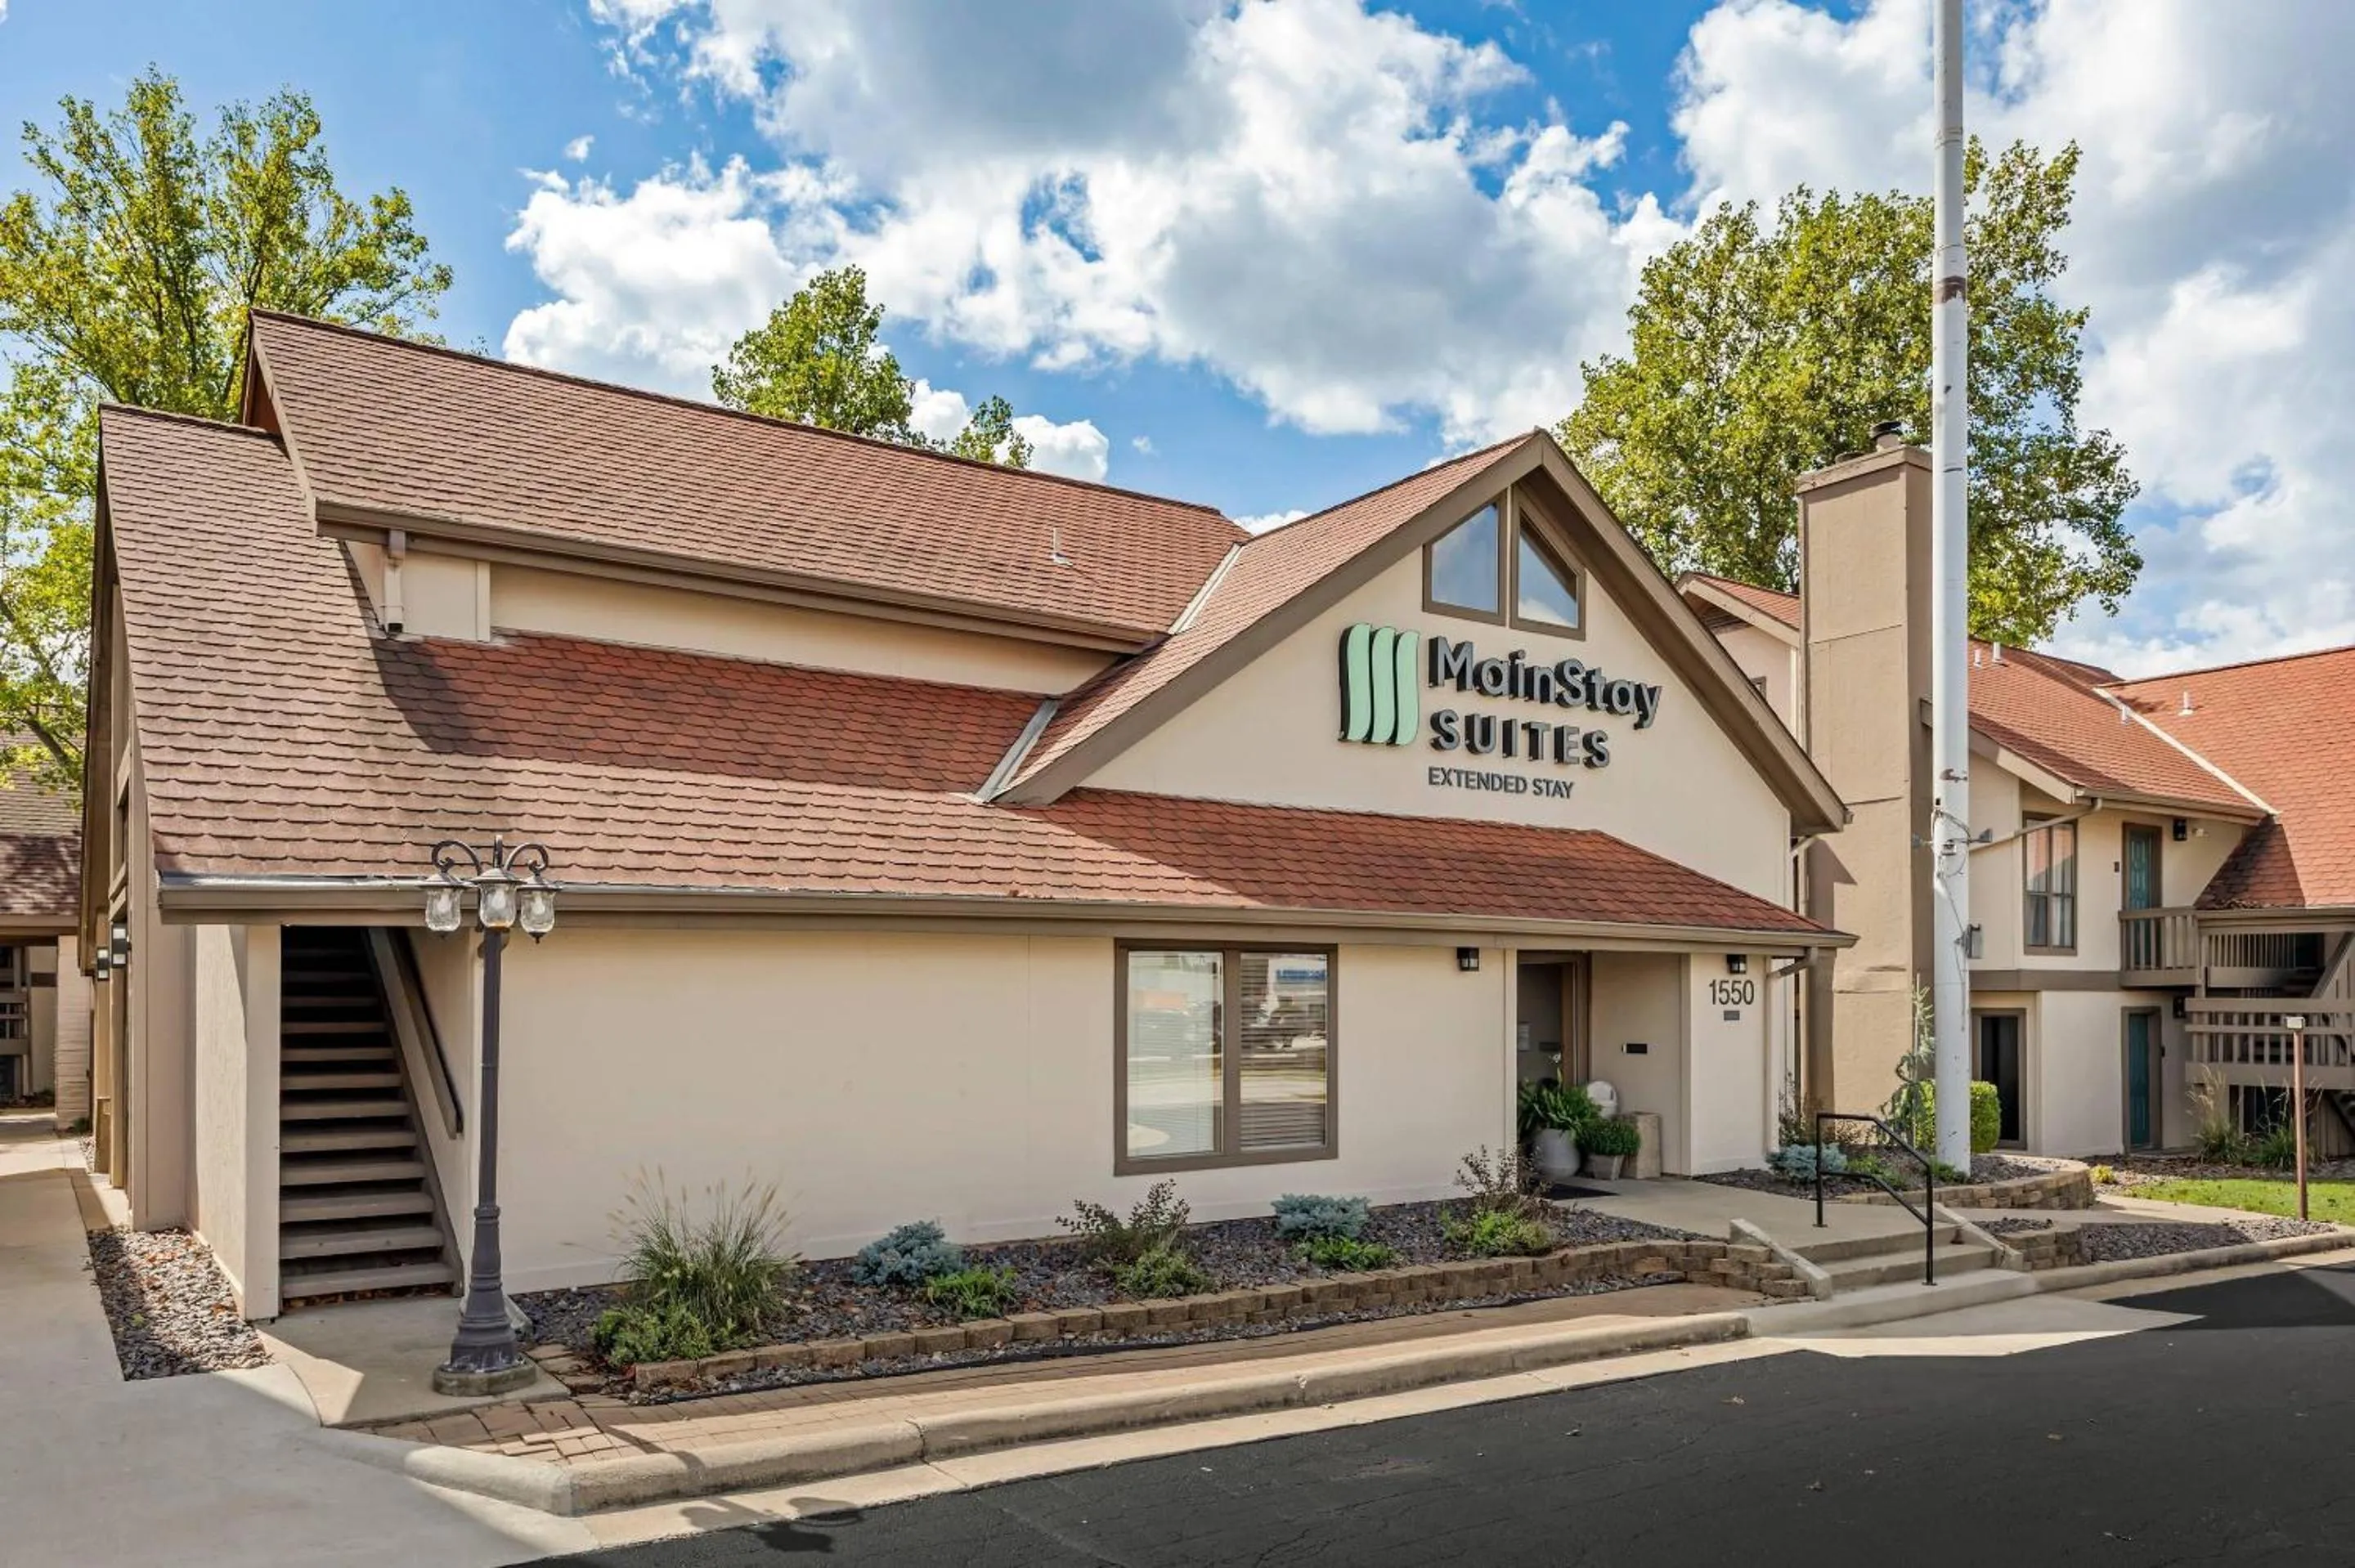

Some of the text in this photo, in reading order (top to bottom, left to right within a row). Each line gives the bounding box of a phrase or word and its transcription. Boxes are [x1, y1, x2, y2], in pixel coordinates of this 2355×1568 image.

[1428, 635, 1663, 729] MainStay
[1430, 709, 1611, 768] SUITES
[1428, 766, 1575, 800] EXTENDED STAY
[1708, 979, 1755, 1006] 1550
